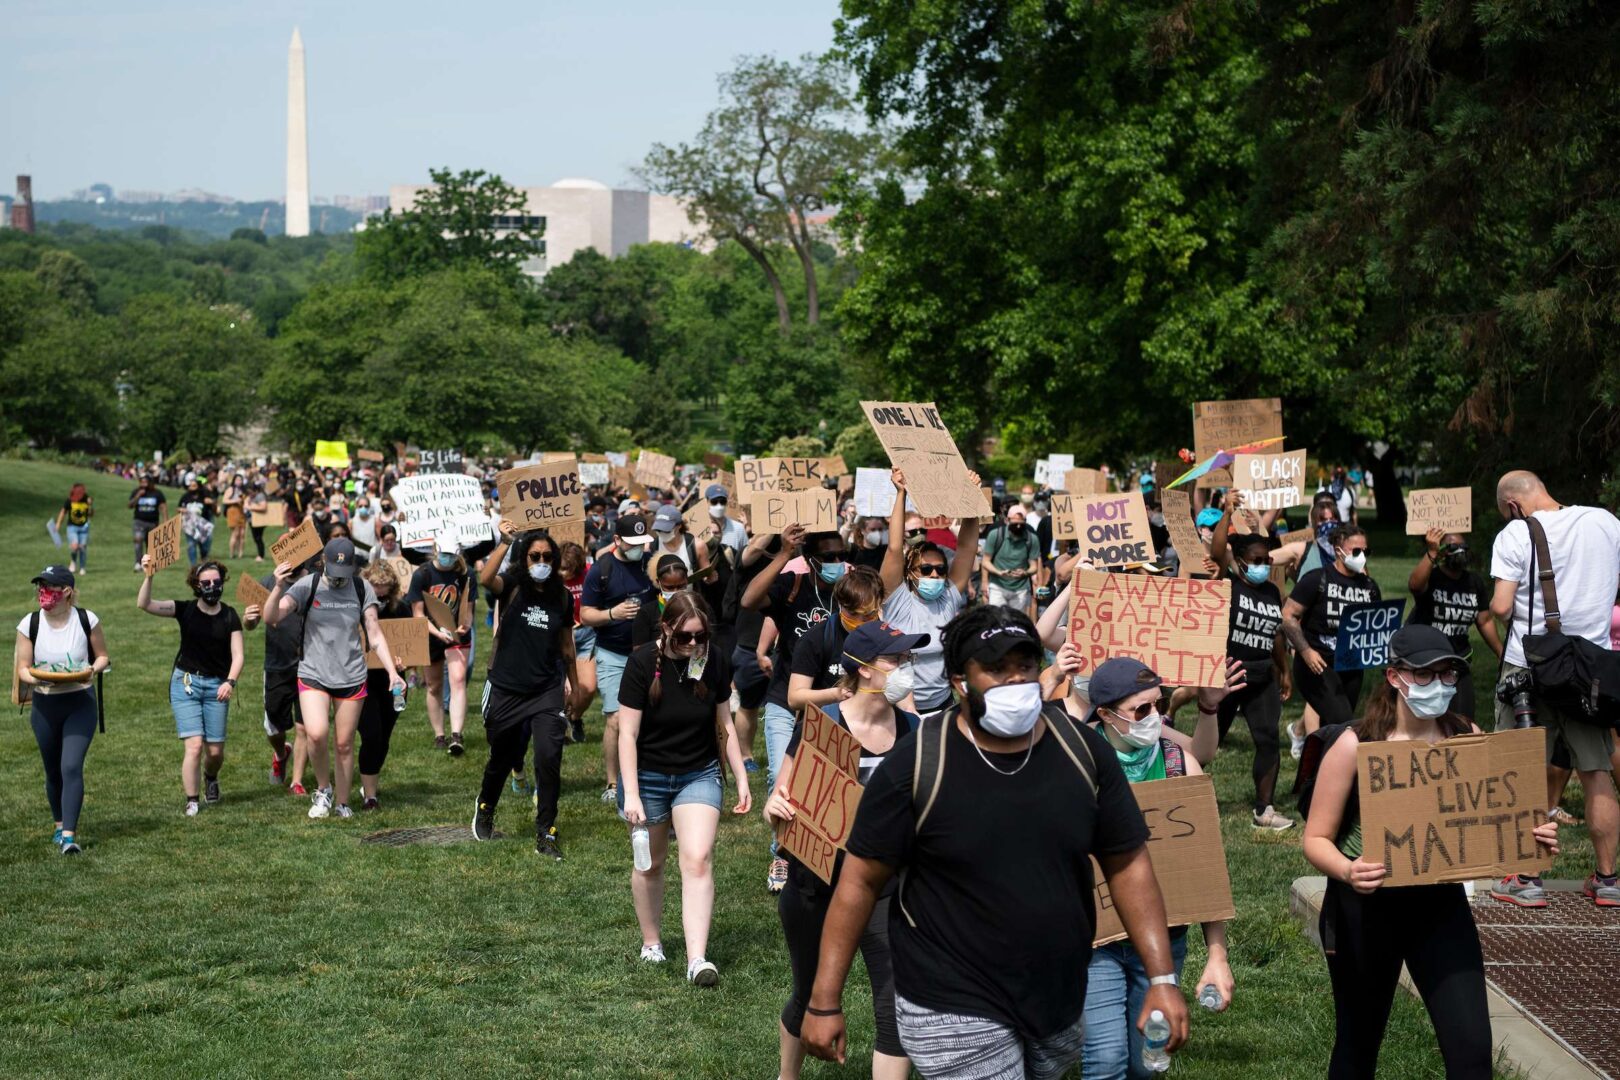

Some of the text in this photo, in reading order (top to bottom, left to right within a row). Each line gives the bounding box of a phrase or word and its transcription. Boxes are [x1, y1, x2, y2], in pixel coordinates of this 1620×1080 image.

[872, 406, 912, 427] ONE
[743, 460, 821, 483] BLACK
[1250, 457, 1301, 480] BLACK
[404, 477, 438, 491] STOP
[515, 472, 581, 502] POLICE
[1253, 477, 1294, 491] LIVES
[403, 494, 428, 507] OUR
[540, 500, 553, 509] the
[1086, 499, 1130, 521] NOT
[1412, 493, 1462, 506] WE WILL
[406, 507, 454, 524] BLACK
[525, 504, 575, 522] POLICE
[1411, 507, 1453, 520] NOT BE
[153, 520, 176, 549] BLACK
[407, 528, 440, 541] NOT
[442, 519, 457, 529] IS
[1056, 516, 1074, 535] is
[1086, 522, 1134, 543] ONE
[271, 525, 306, 555] END WHITE
[155, 543, 175, 560] LIVES
[1087, 541, 1150, 565] MORE
[1074, 569, 1227, 612] LAWYERS
[1327, 583, 1371, 604] BLACK
[1432, 588, 1478, 607] BLACK
[1072, 595, 1225, 635] AGAINST
[1345, 607, 1399, 631] STOP
[1070, 617, 1172, 651] POLICE
[1360, 646, 1388, 665] US!
[803, 703, 860, 781] BLACK
[1368, 747, 1460, 793] BLACK
[786, 743, 857, 844] LIVES
[1436, 771, 1519, 813] LIVES
